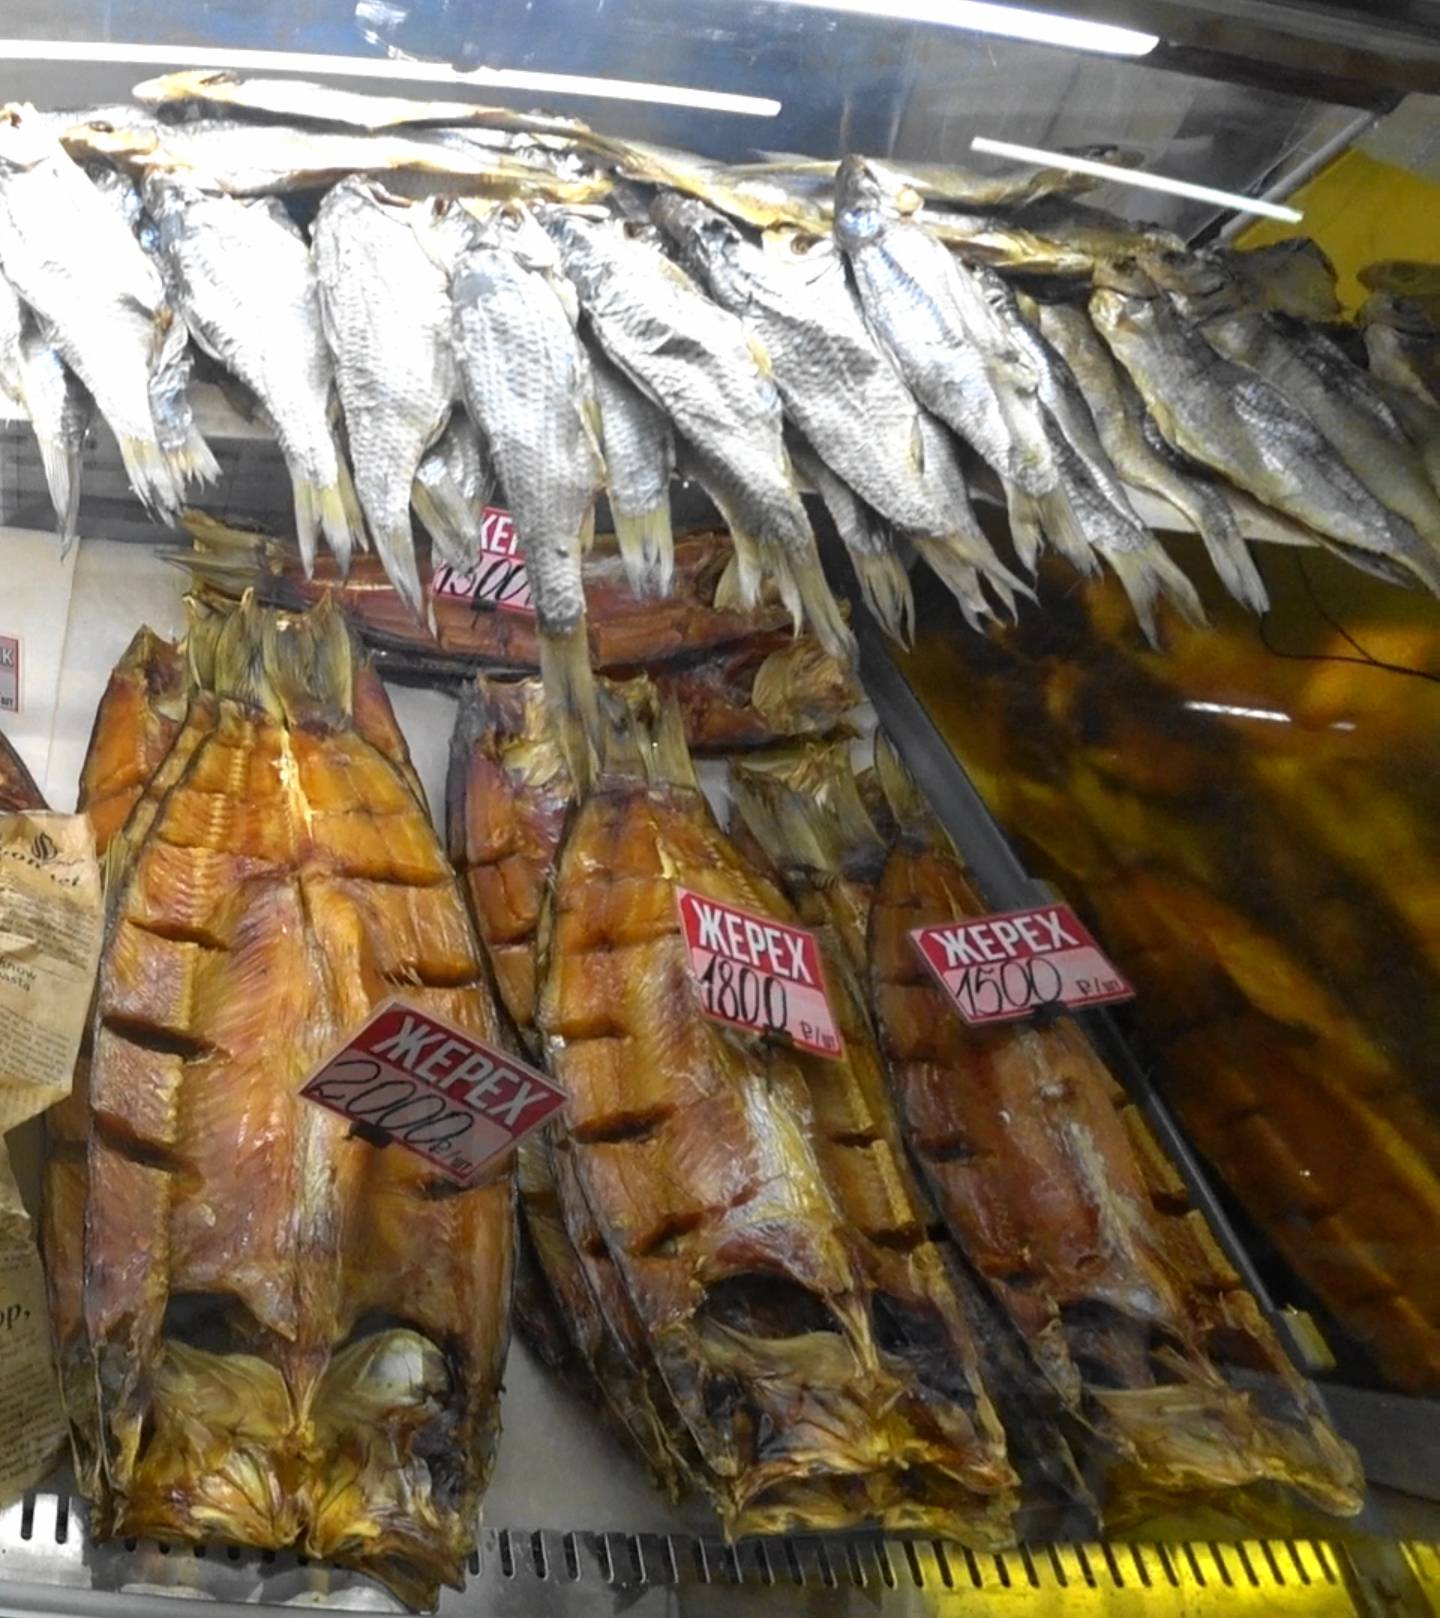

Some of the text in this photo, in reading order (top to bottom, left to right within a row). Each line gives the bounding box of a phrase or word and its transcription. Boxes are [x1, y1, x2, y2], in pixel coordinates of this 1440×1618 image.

[690, 898, 815, 986] ЖЕРЕХ
[928, 910, 1080, 968] ЖЕРЕХ
[700, 954, 788, 1032] 1800
[956, 956, 1063, 1015] 1500
[312, 1059, 475, 1144] 2000
[368, 1014, 550, 1127] ЖЕРЕХ
